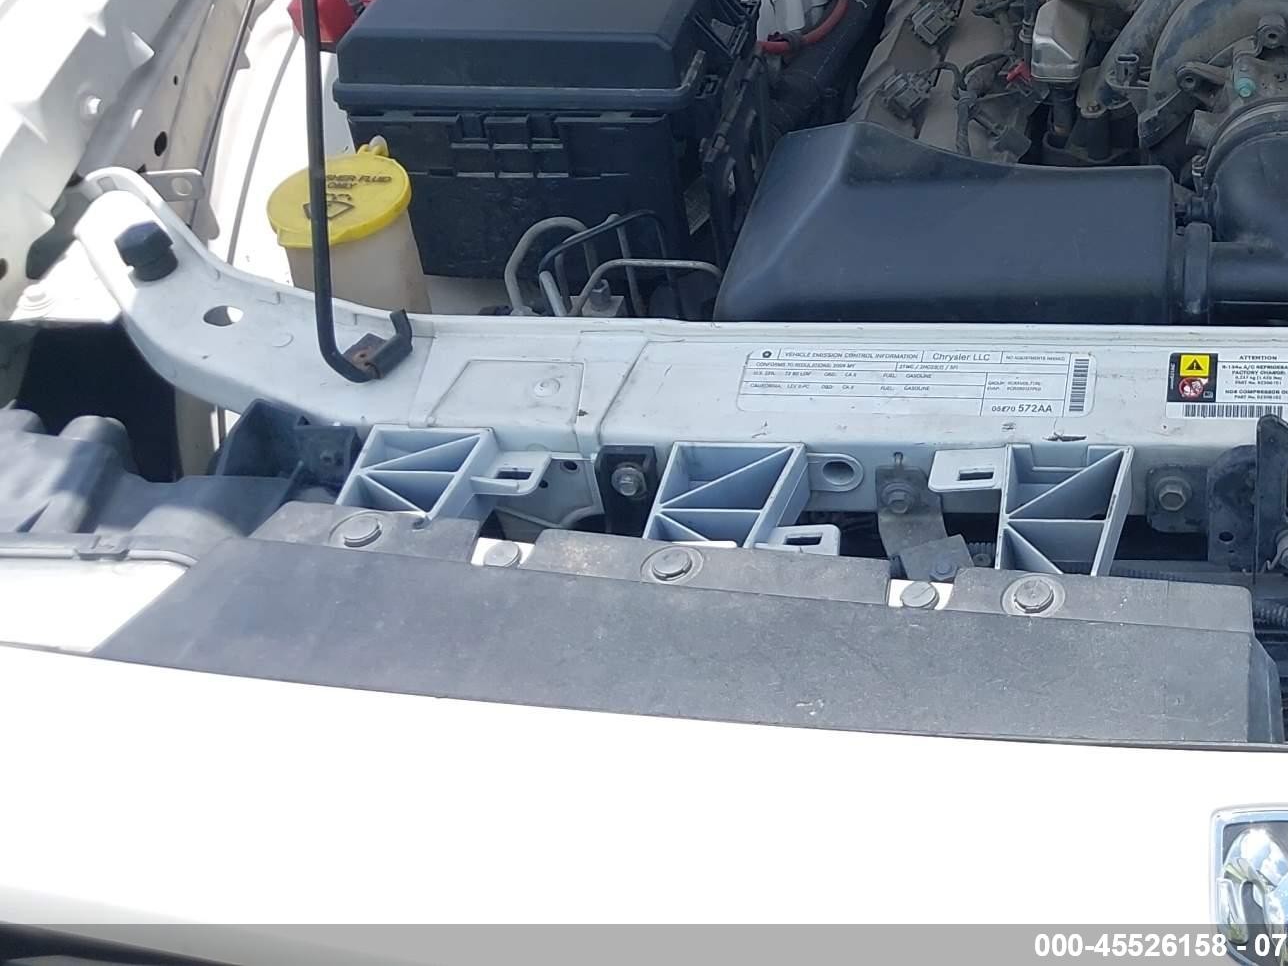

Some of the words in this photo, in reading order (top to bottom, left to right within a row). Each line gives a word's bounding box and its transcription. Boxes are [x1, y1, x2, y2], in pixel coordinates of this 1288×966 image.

[358, 175, 393, 183] FLUID
[932, 352, 971, 363] Chrysler
[972, 353, 990, 362] LLC
[1018, 404, 1052, 413] 572AA
